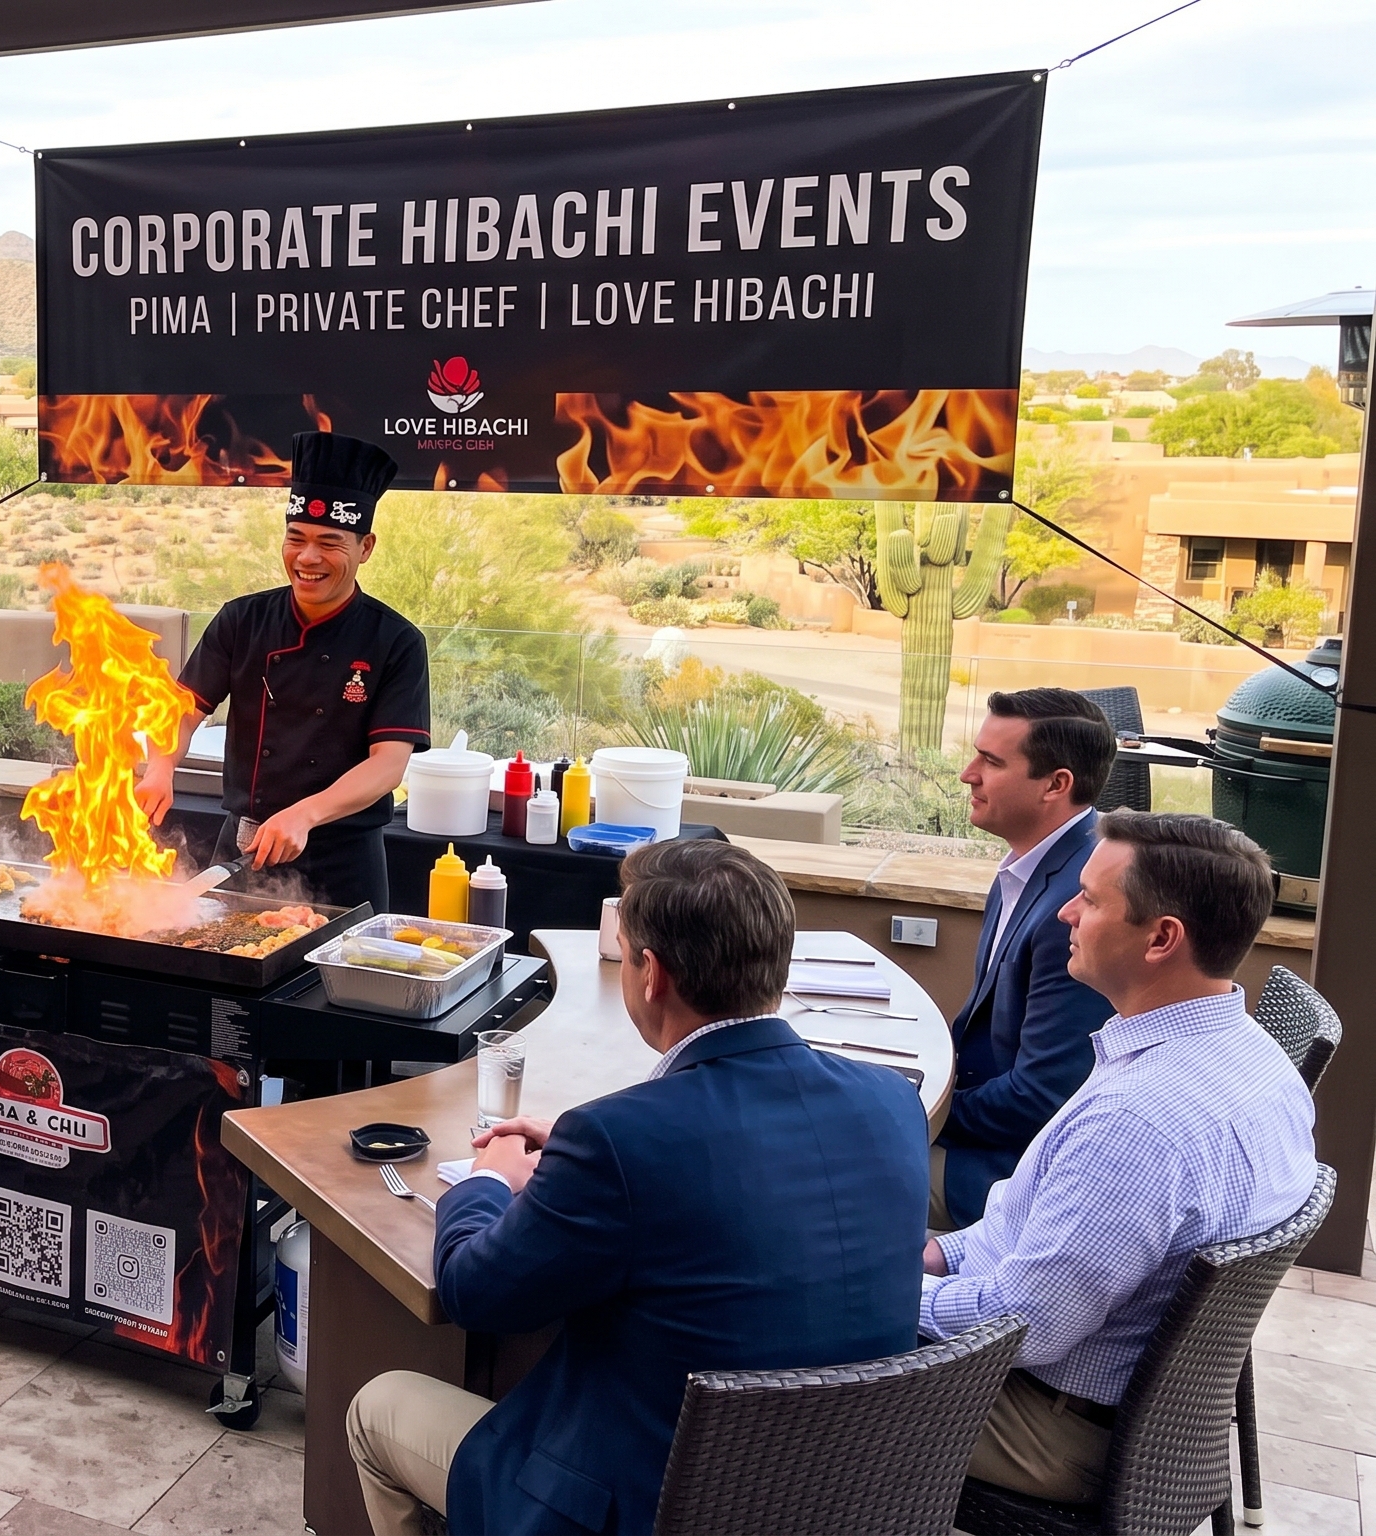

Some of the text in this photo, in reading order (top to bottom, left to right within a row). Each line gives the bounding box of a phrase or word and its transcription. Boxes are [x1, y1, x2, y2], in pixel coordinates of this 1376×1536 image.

[72, 165, 970, 277] CORPORATE HIBACHI EVENTS
[130, 295, 211, 335] PIMA
[257, 289, 406, 333] PRIVATE
[421, 285, 518, 329] CHEF
[571, 280, 676, 326] LOVE
[693, 272, 875, 323] HIBACHI
[384, 418, 529, 436] LOVE HIBACHI
[26, 1109, 38, 1126] &
